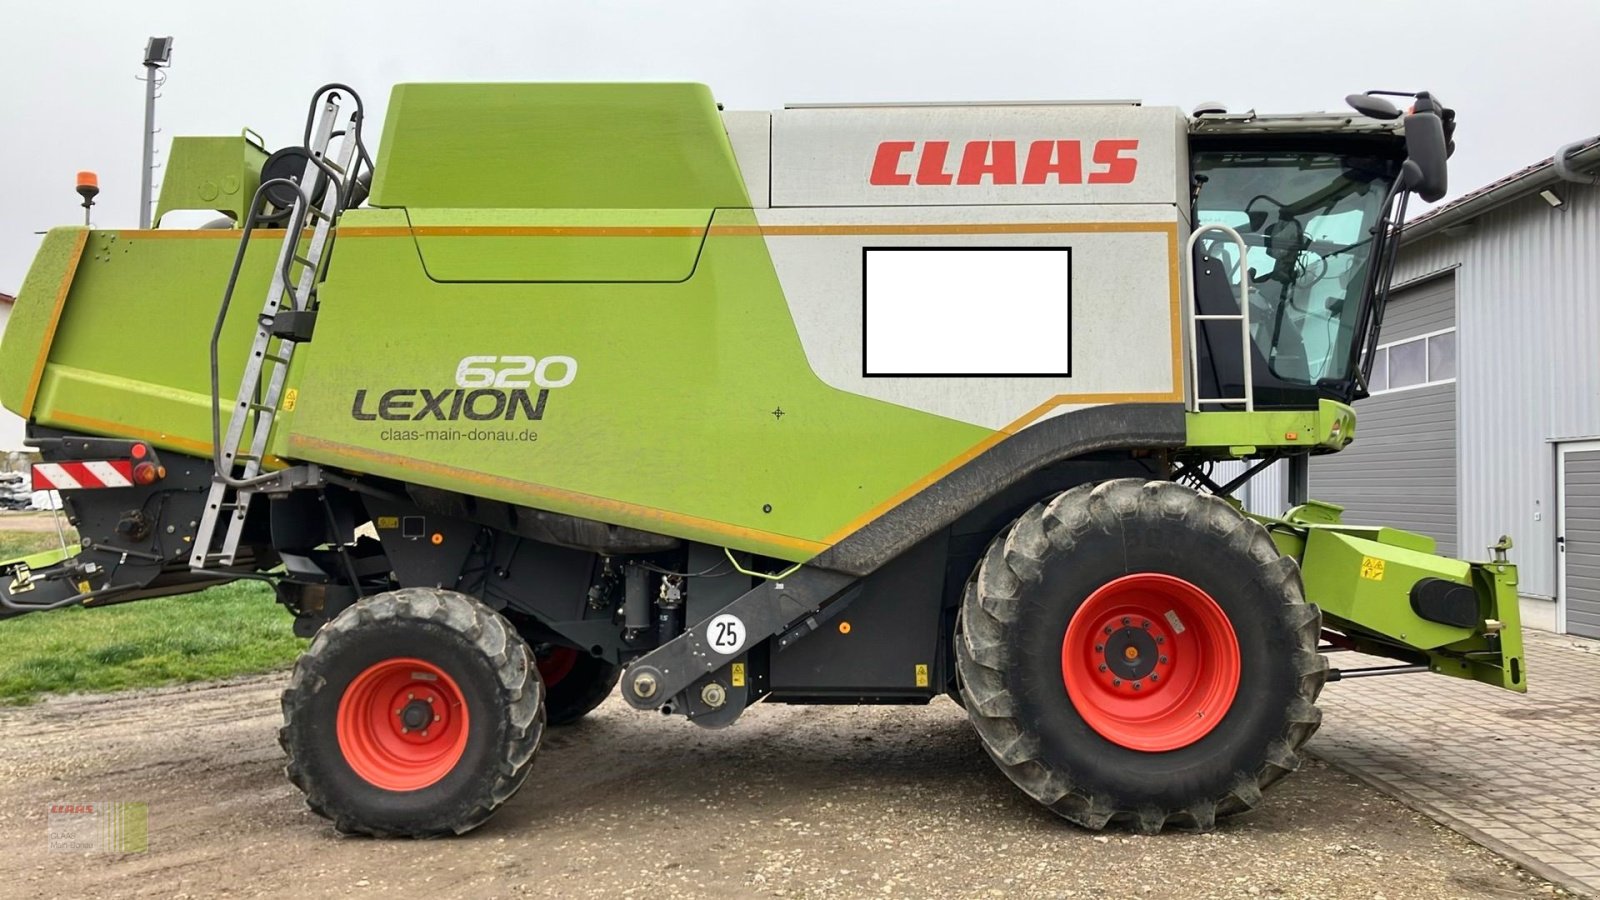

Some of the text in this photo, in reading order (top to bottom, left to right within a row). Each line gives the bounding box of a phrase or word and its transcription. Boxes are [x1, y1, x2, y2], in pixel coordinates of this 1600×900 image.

[870, 140, 1138, 185] CLAAS
[455, 355, 578, 388] 620
[351, 389, 549, 421] LEXION
[380, 427, 538, 442] claas-main-donau.de
[716, 622, 737, 646] 25
